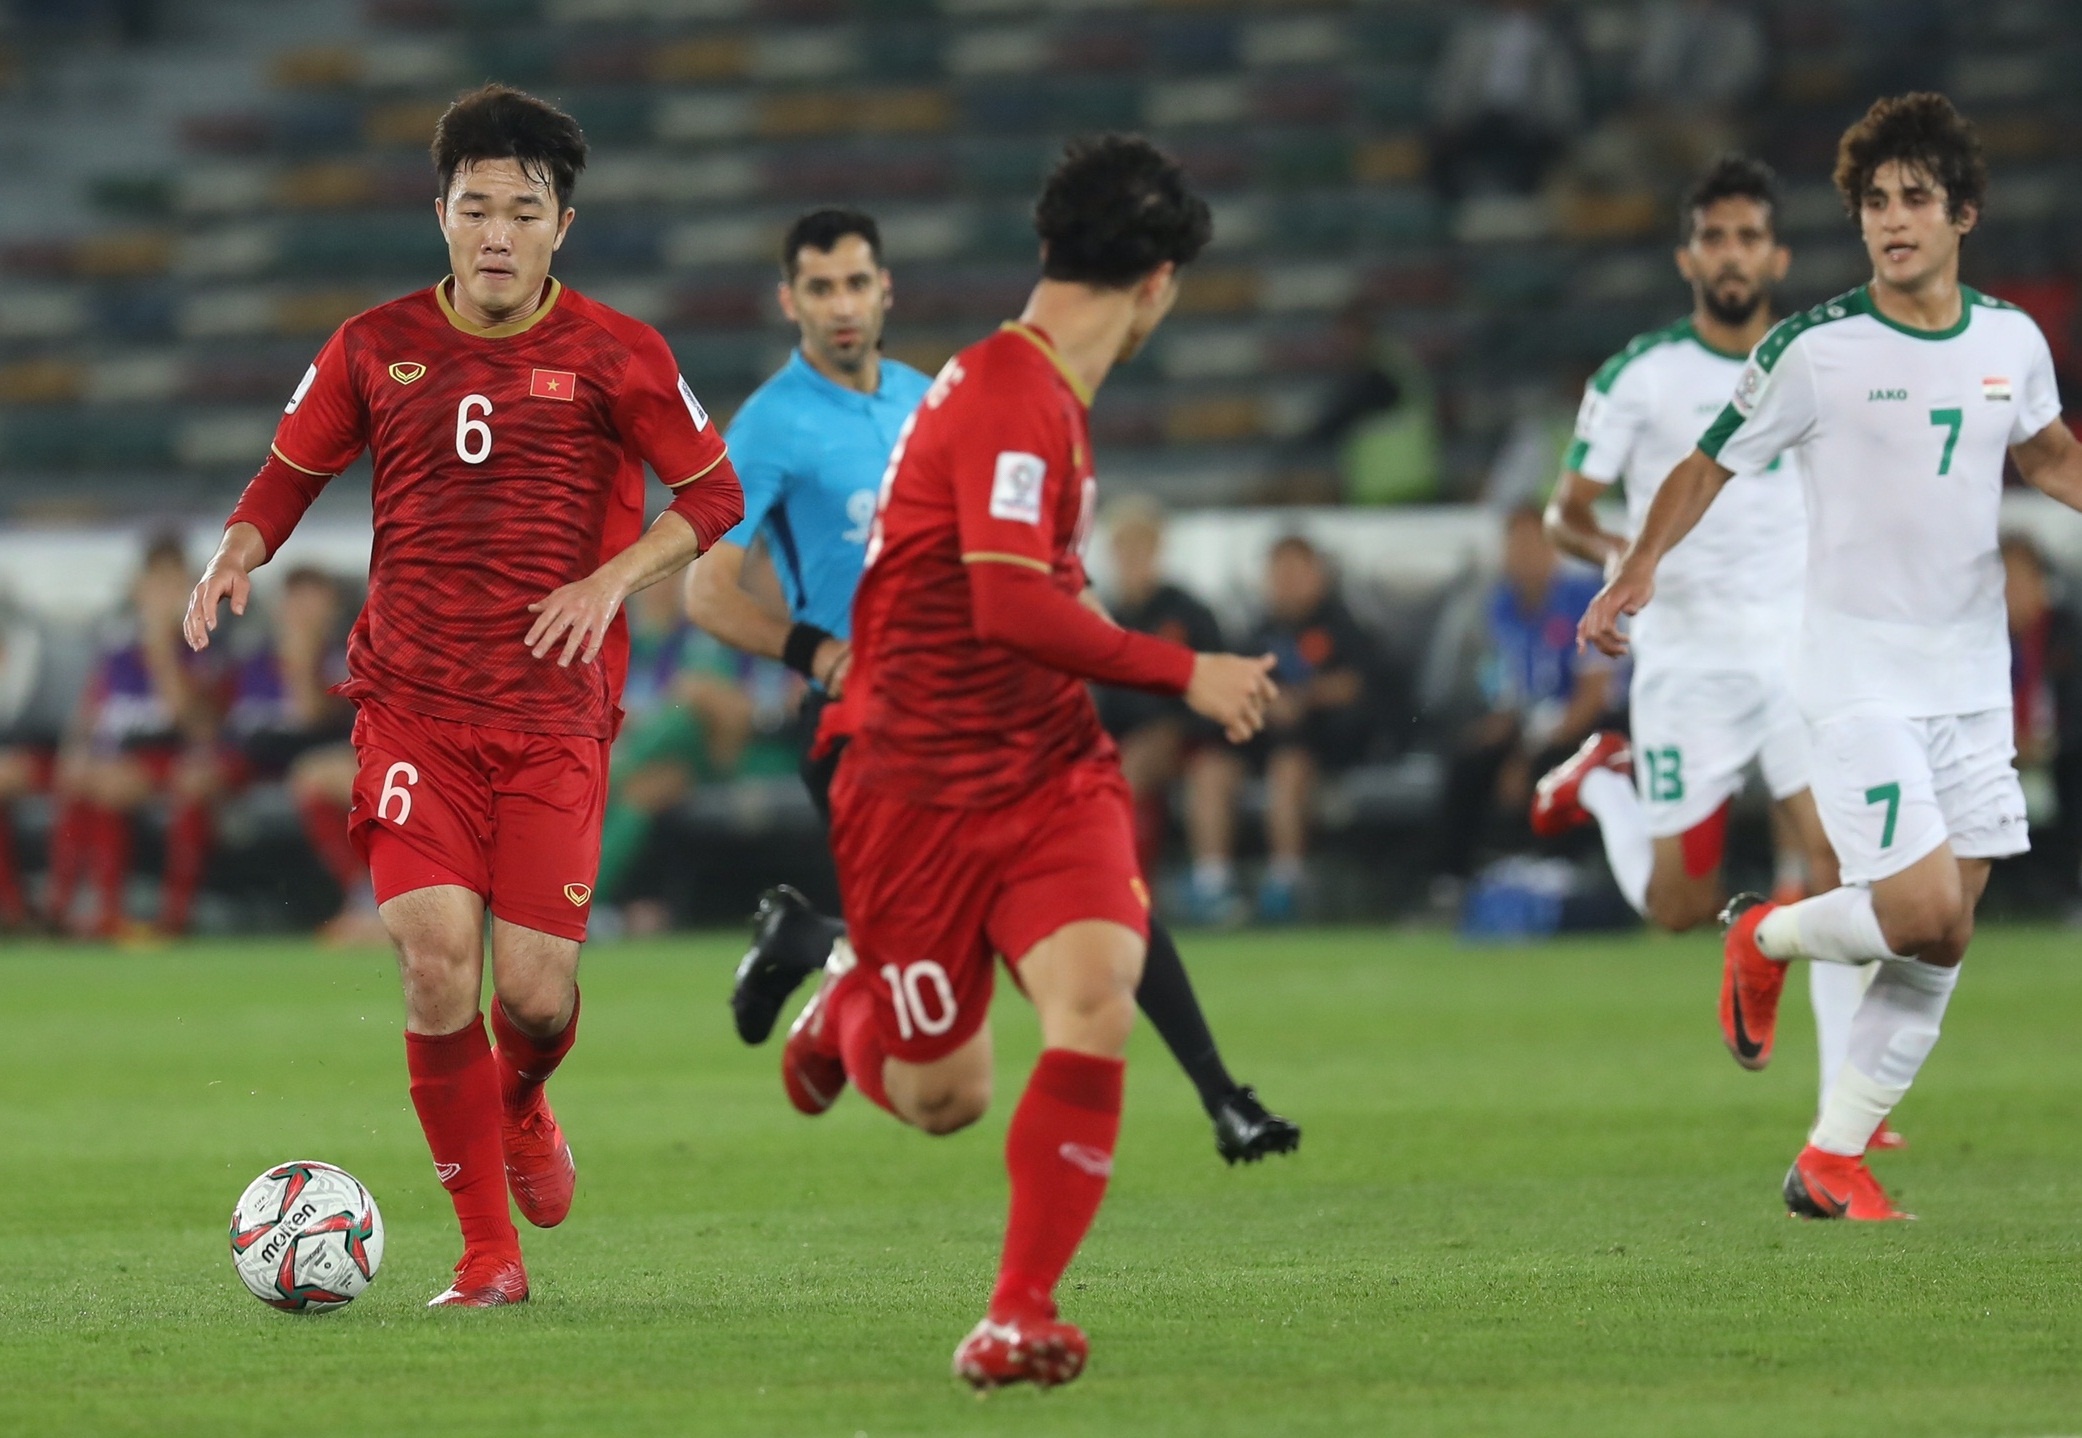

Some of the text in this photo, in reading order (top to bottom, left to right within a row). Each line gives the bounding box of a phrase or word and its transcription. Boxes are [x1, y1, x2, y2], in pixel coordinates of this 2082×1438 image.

[1867, 389, 1908, 402] JAKO
[456, 394, 493, 464] 6
[1930, 408, 1963, 475] 7
[378, 761, 418, 825] 6
[1645, 748, 1684, 801] 13
[1865, 782, 1901, 849] 7
[880, 960, 958, 1040] 10
[261, 1203, 317, 1264] molten
